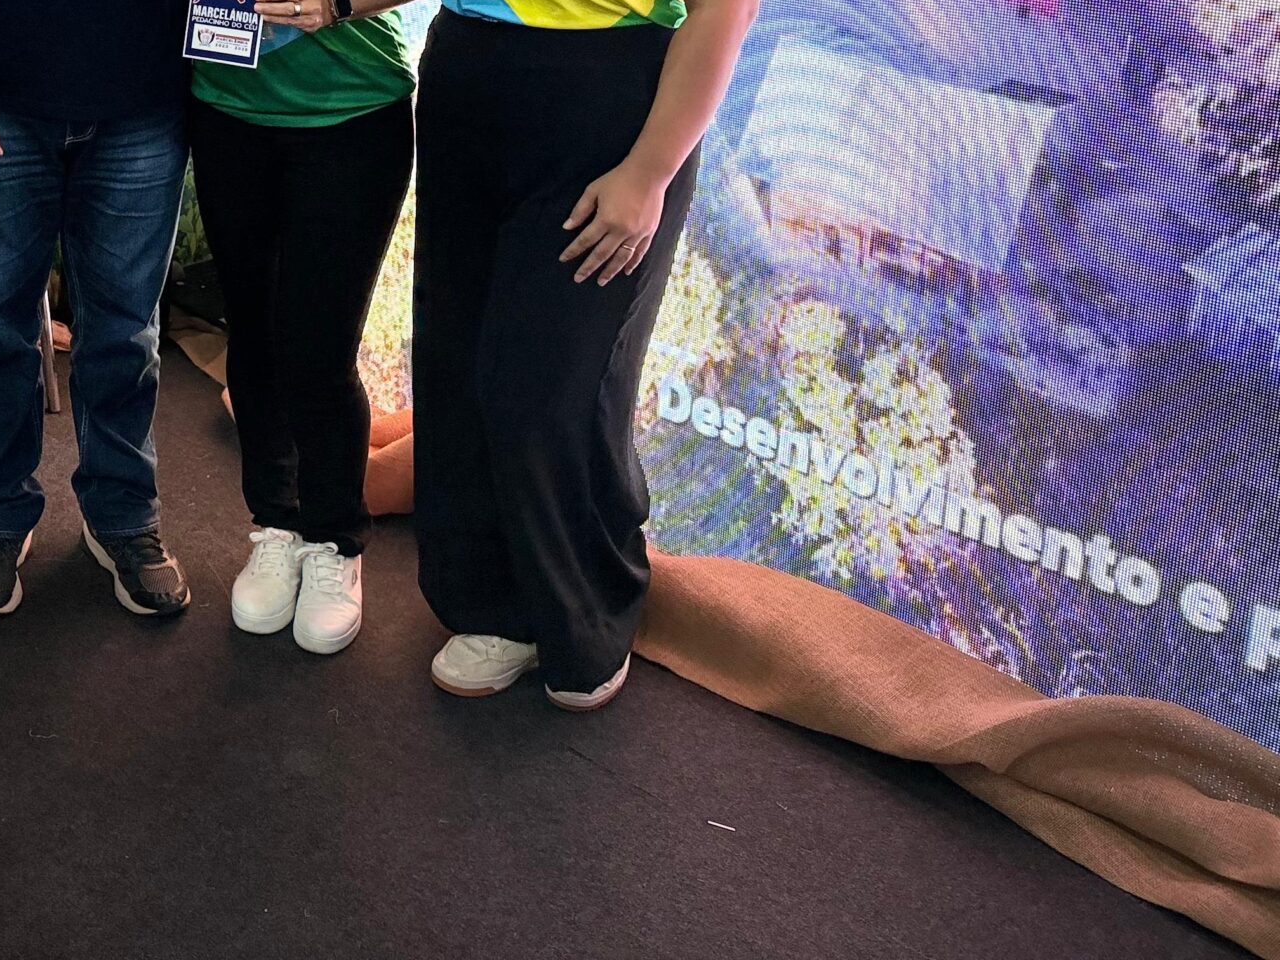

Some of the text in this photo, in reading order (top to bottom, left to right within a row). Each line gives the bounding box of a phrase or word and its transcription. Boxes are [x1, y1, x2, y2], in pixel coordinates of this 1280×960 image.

[191, 15, 230, 27] PEDACINHO
[231, 21, 242, 29] DO
[192, 4, 258, 25] MARCELÂNDIA
[657, 373, 1163, 608] Desenvolvimento
[1178, 579, 1231, 633] e
